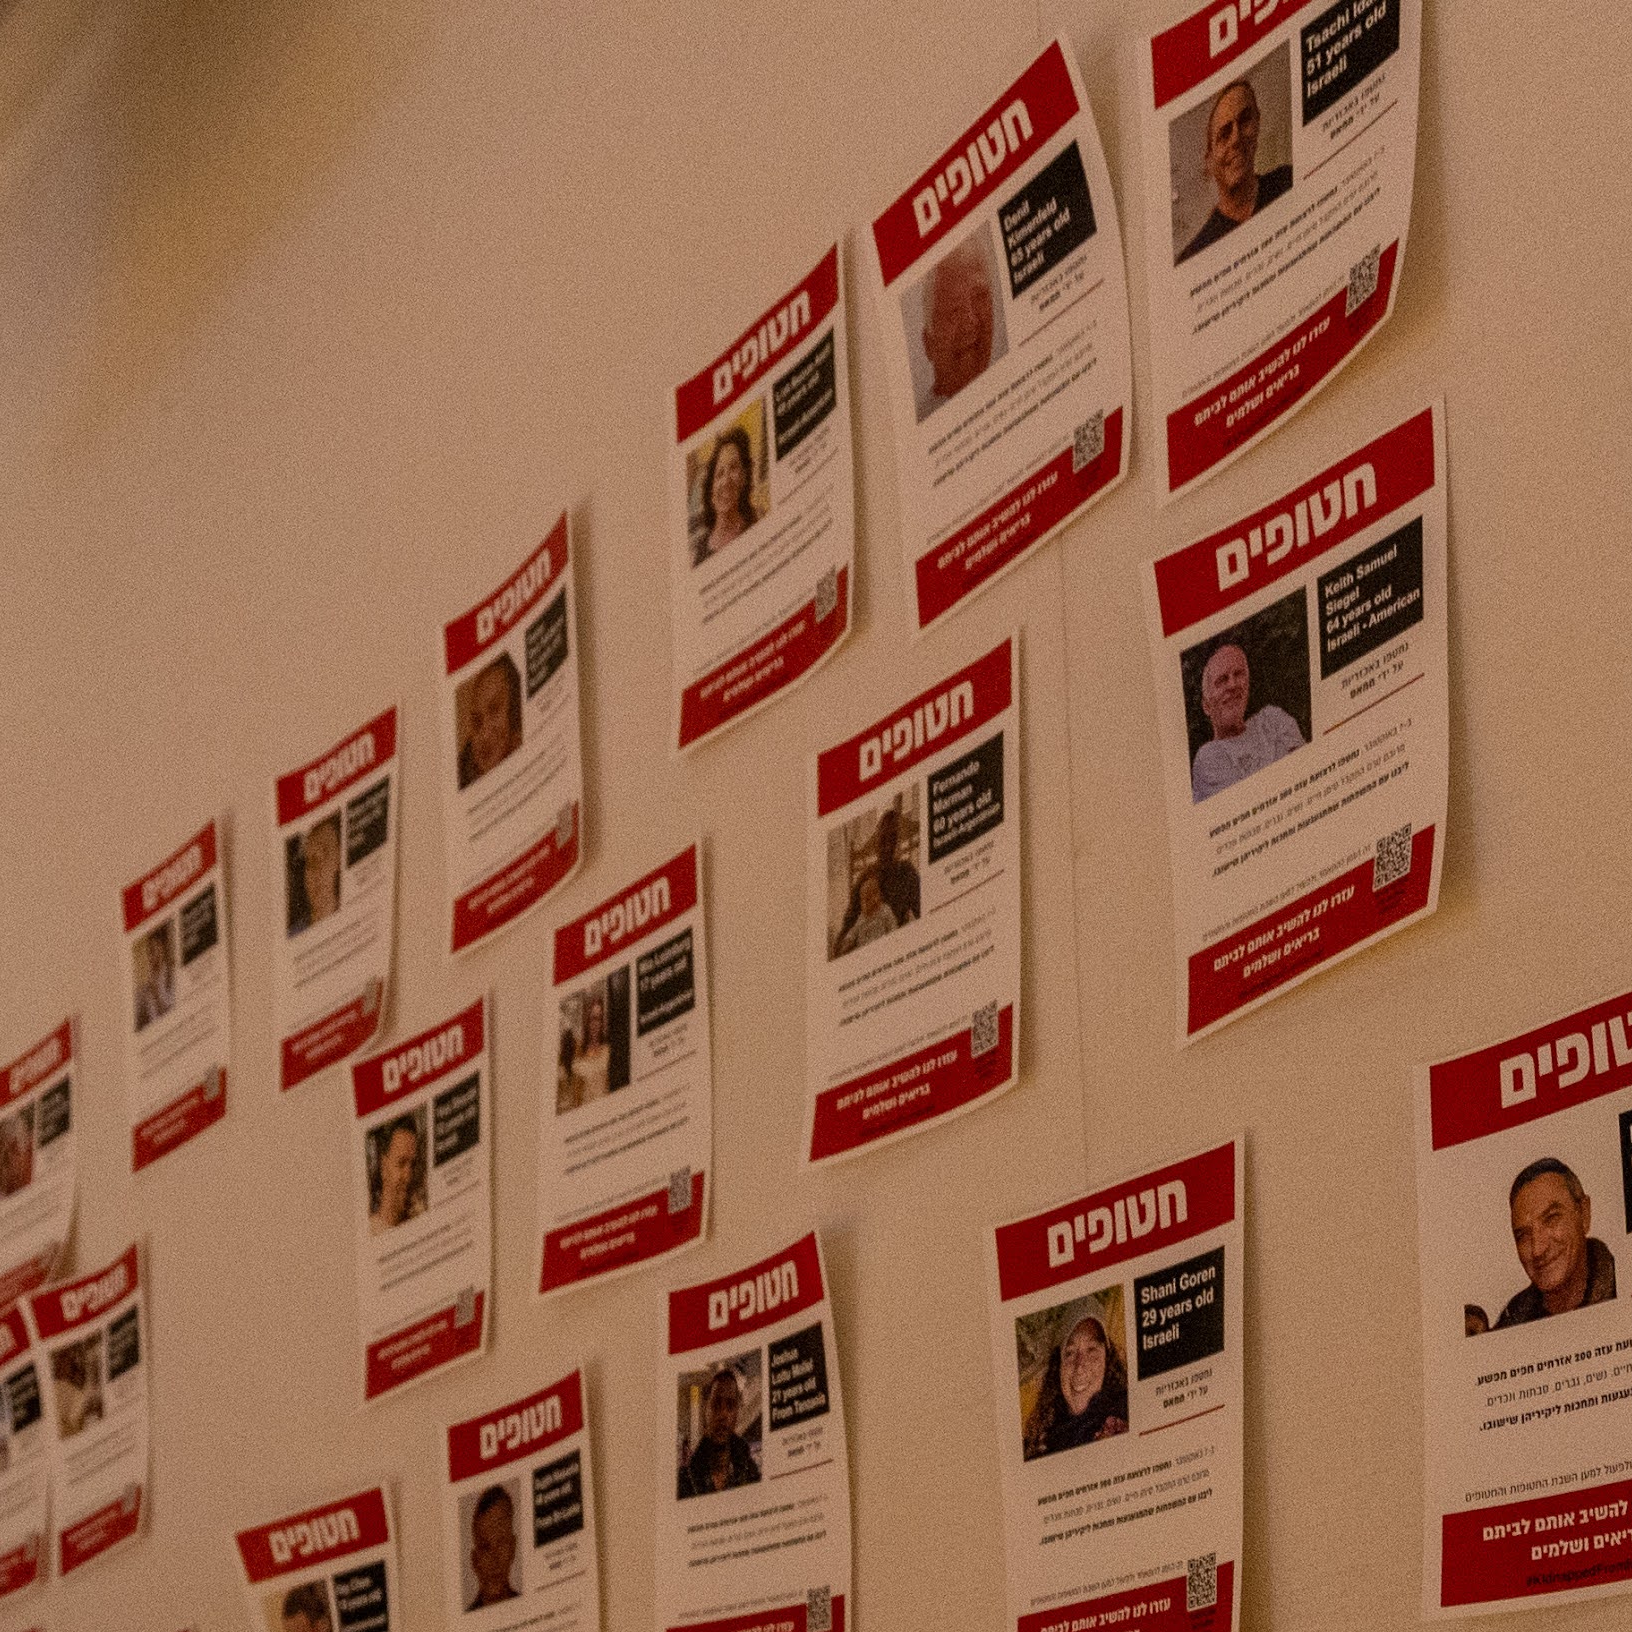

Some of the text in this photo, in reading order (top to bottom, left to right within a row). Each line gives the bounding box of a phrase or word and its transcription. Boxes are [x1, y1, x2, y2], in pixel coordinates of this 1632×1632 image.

[911, 98, 1033, 237] חטופים
[712, 290, 810, 404] חטופים
[1215, 462, 1377, 591] חטופים
[858, 680, 974, 781] חטופים
[583, 876, 670, 957] חטופים
[1046, 1179, 1188, 1268] חטופים
[707, 1259, 798, 1330] חטופים
[1140, 1265, 1216, 1304] Shani Goren
[1141, 1286, 1214, 1327] 29 years old
[1141, 1322, 1180, 1350] Israeli
[479, 1394, 560, 1459] חטופים
[1481, 1518, 1531, 1541] לביתם
[1534, 1511, 1575, 1532] אותם
[1578, 1499, 1628, 1524] להשיב
[1530, 1536, 1589, 1561] ושלמים
